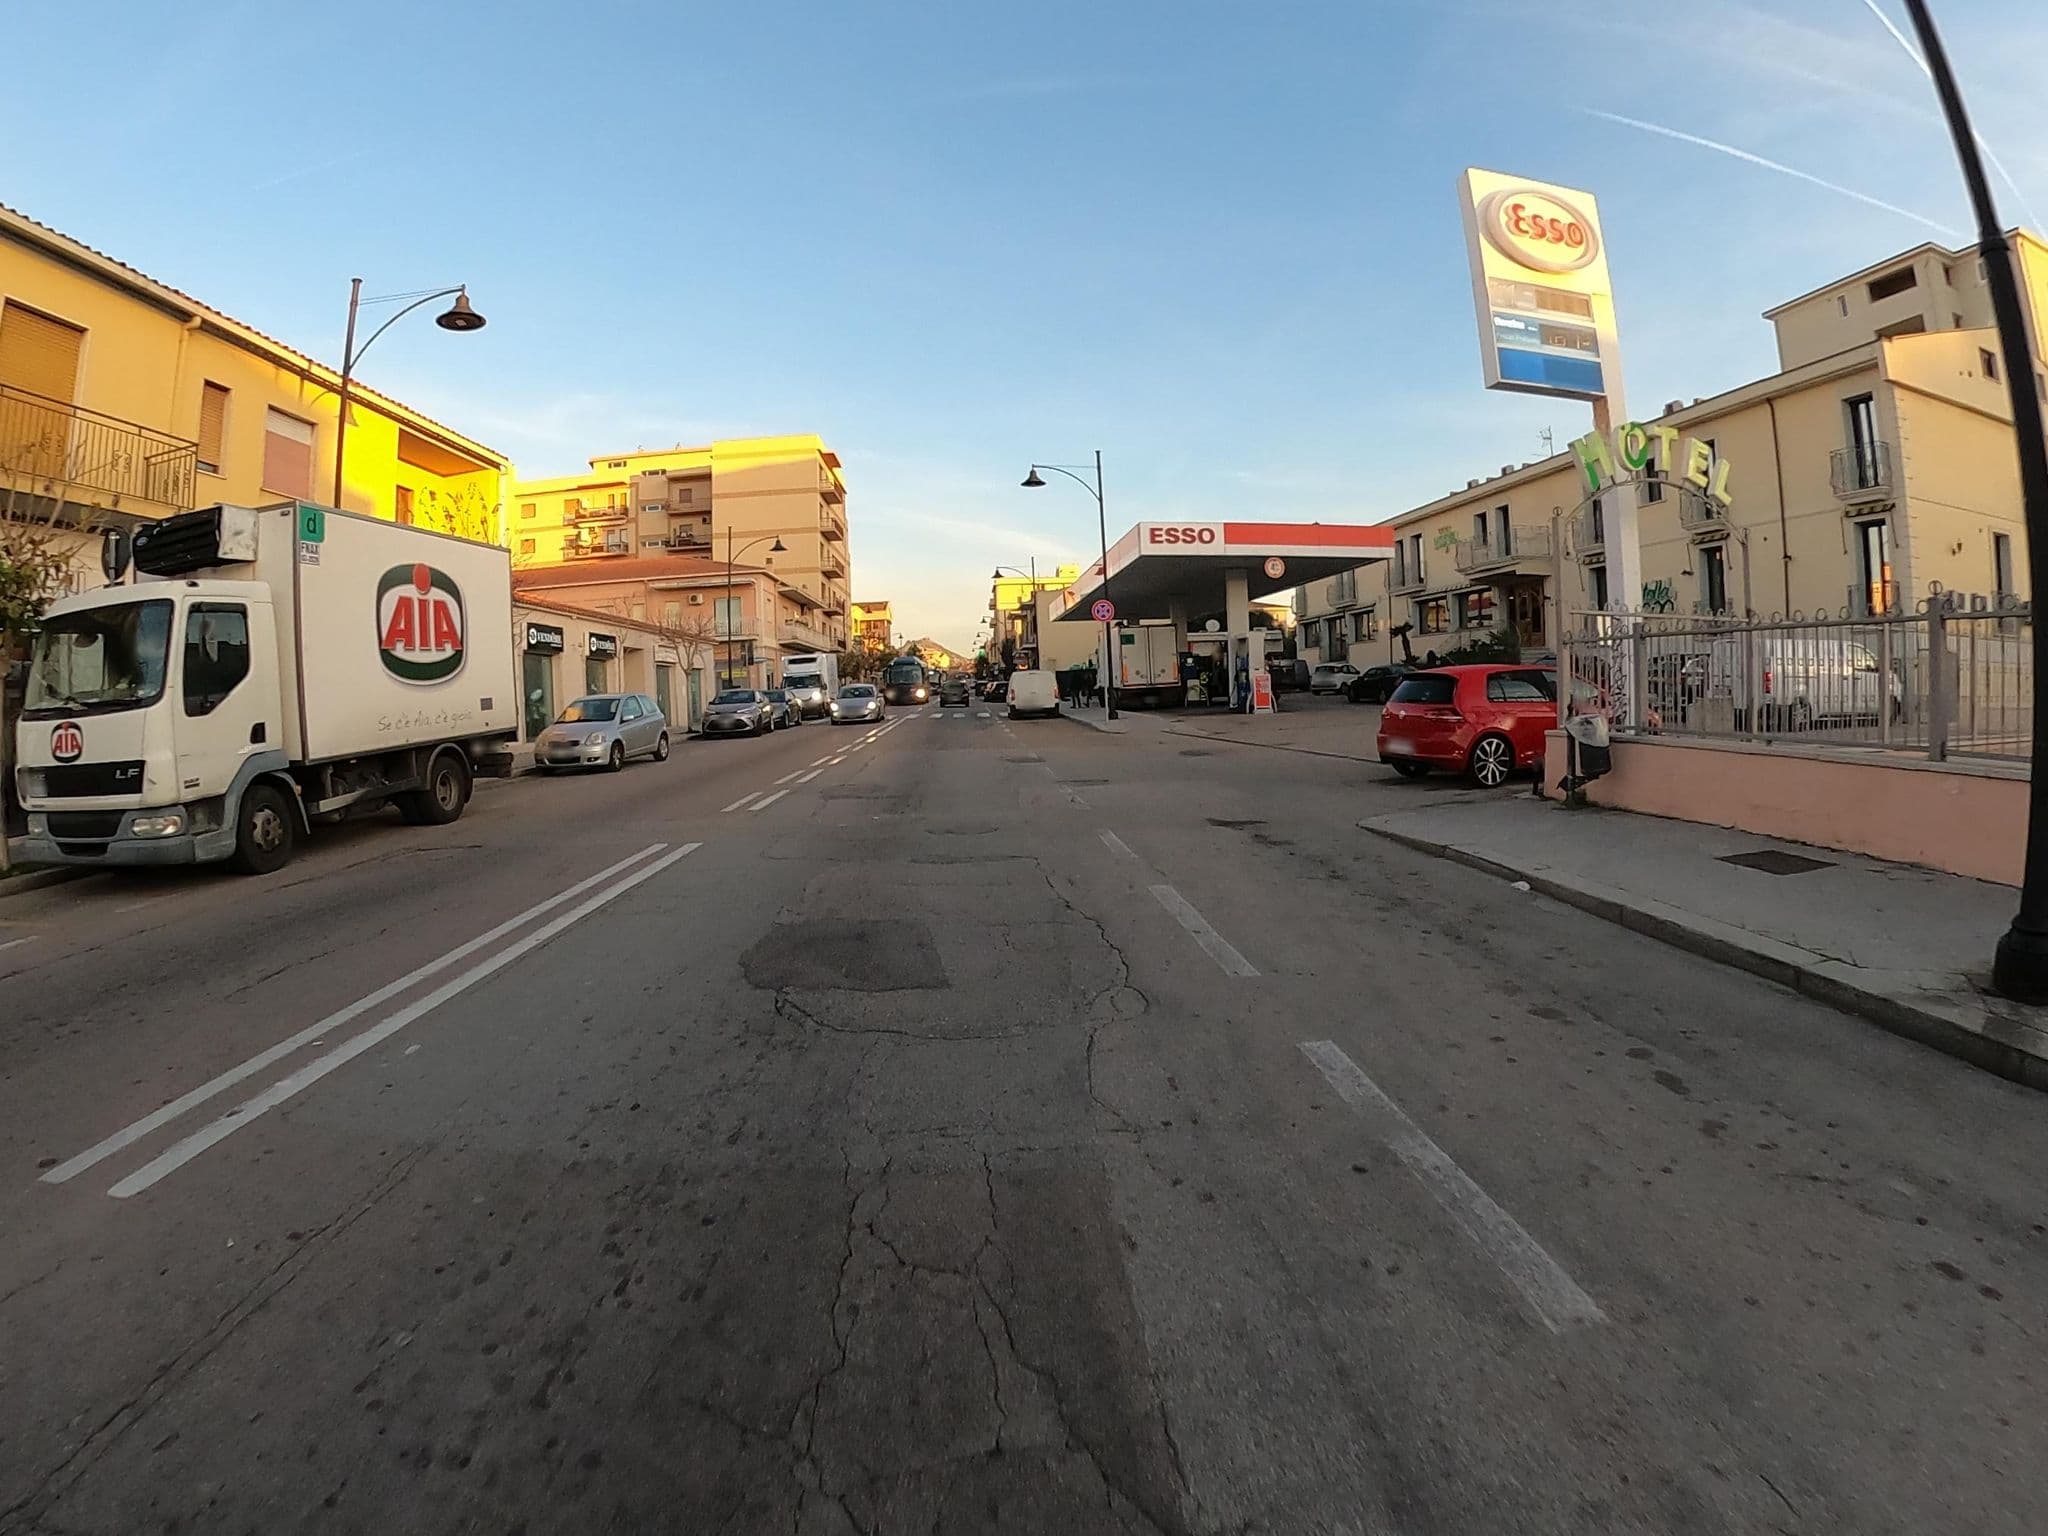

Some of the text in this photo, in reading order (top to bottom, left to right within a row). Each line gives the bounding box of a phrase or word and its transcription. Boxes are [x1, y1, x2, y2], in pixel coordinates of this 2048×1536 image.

[1504, 203, 1583, 248] ESSO
[1568, 421, 1733, 506] HOTEL
[1149, 527, 1216, 545] ESSO
[381, 595, 464, 652] AIA
[53, 732, 82, 754] AIA
[115, 768, 140, 780] LF
